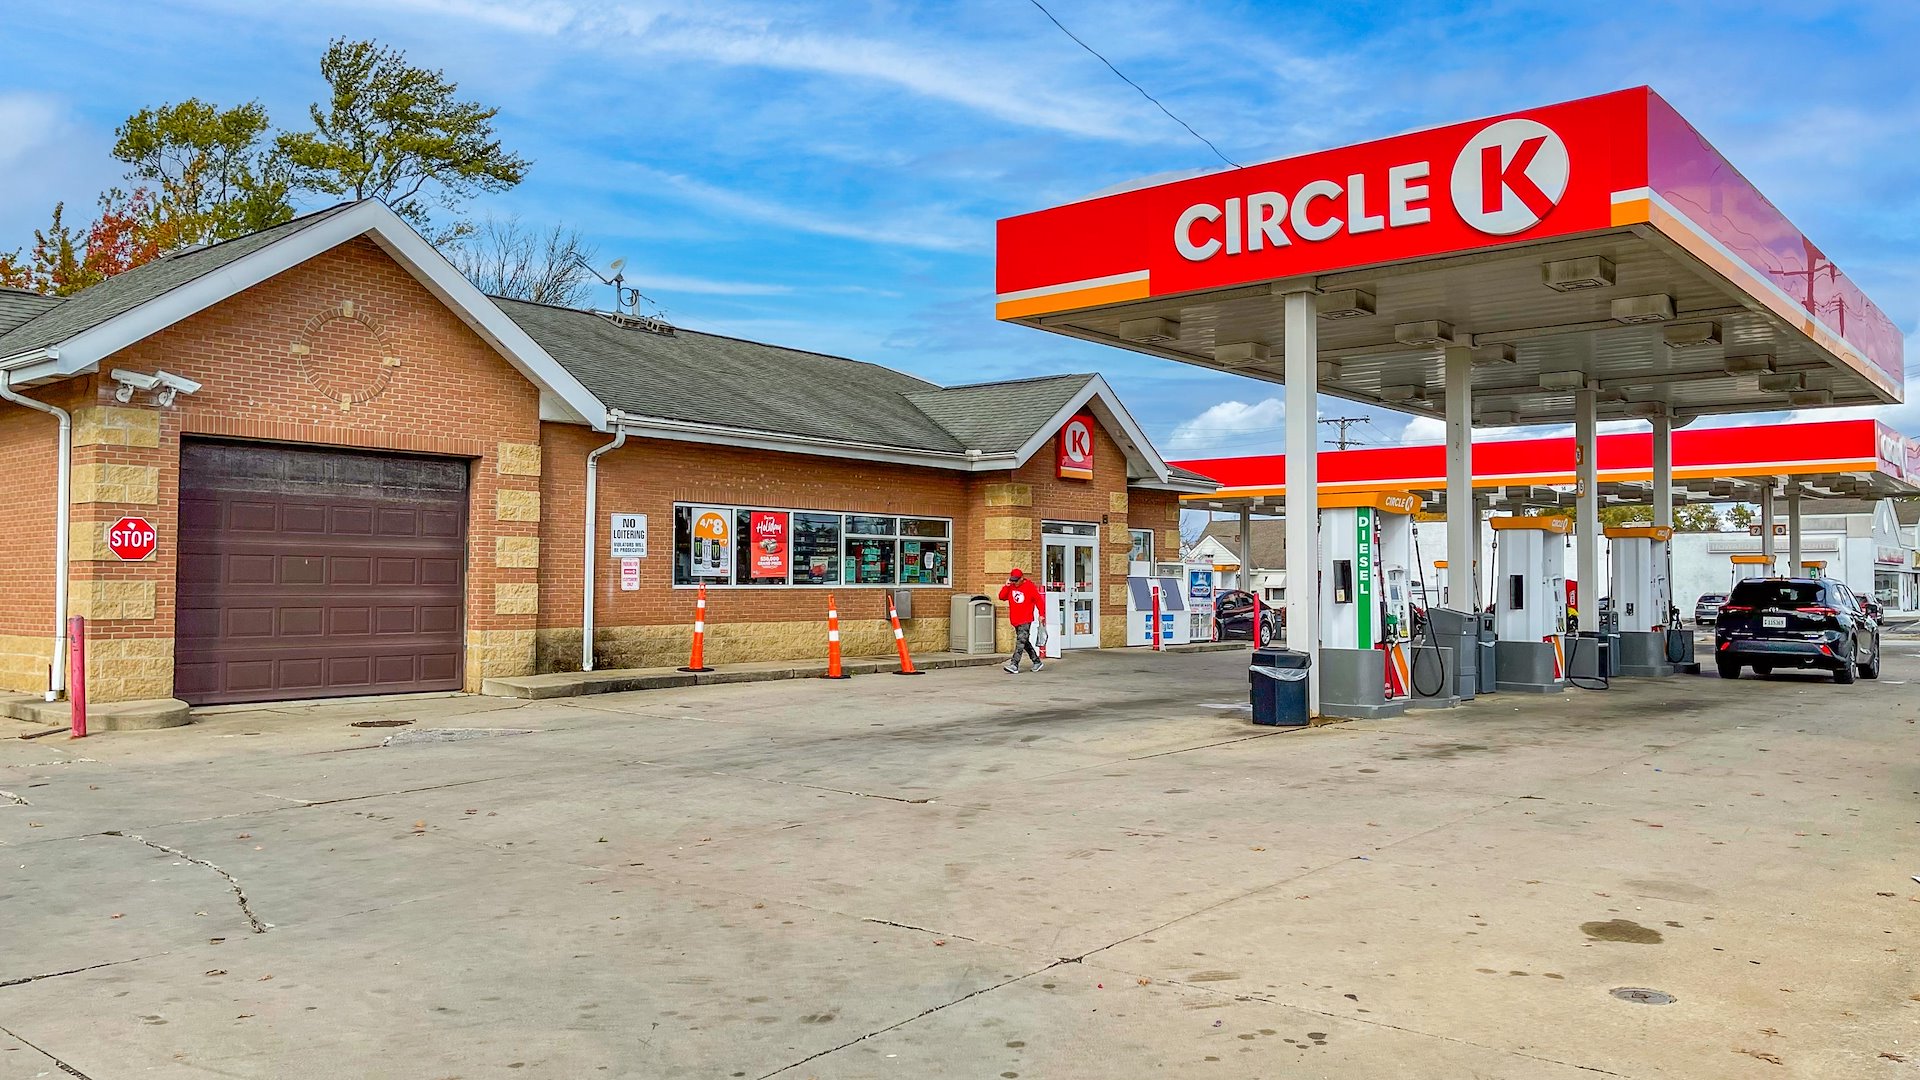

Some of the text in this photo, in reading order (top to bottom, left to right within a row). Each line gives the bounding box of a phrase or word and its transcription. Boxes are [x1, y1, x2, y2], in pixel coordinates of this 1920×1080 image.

[1174, 131, 1558, 262] CIRCLE K
[1070, 428, 1089, 457] K
[1385, 496, 1406, 508] CIRCLE
[622, 518, 636, 528] NO
[111, 530, 154, 548] STOP
[613, 530, 645, 540] LOITERING
[1358, 516, 1370, 595] DIESEL
